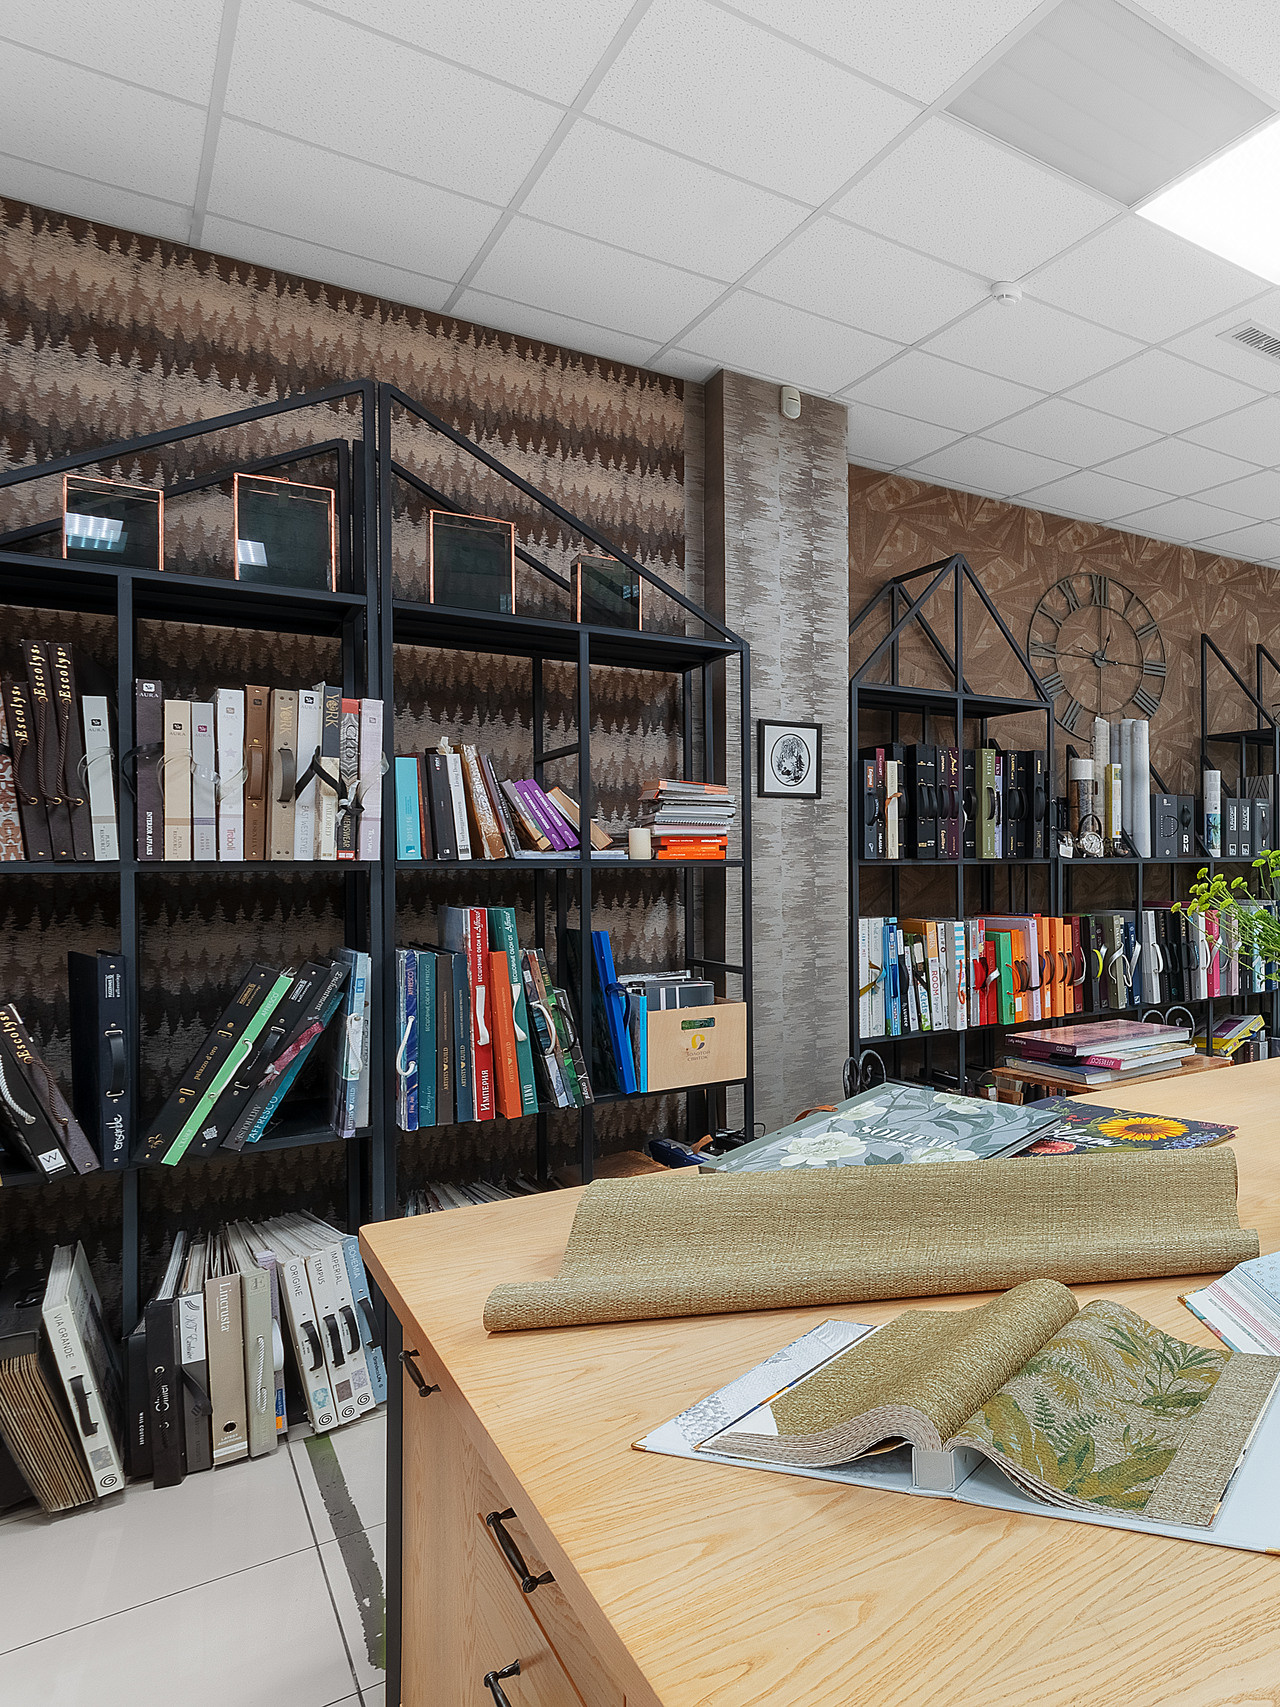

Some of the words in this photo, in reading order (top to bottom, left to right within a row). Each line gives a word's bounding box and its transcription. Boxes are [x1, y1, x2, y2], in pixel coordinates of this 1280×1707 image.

[29, 651, 47, 697] Escolys
[56, 653, 72, 700] Escolys
[13, 692, 29, 741] Escolys
[326, 694, 339, 728] YORK
[1090, 1056, 1116, 1066] AFFRESCO
[250, 1096, 278, 1139] AFFRESCO
[290, 1264, 303, 1298] ORIGINE
[314, 1258, 326, 1286] TEMPUS
[330, 1251, 344, 1286] IMPERIAL
[54, 1314, 64, 1328] VIA
[219, 1282, 232, 1332] Lincrusta
[58, 1326, 75, 1359] GRANDE
